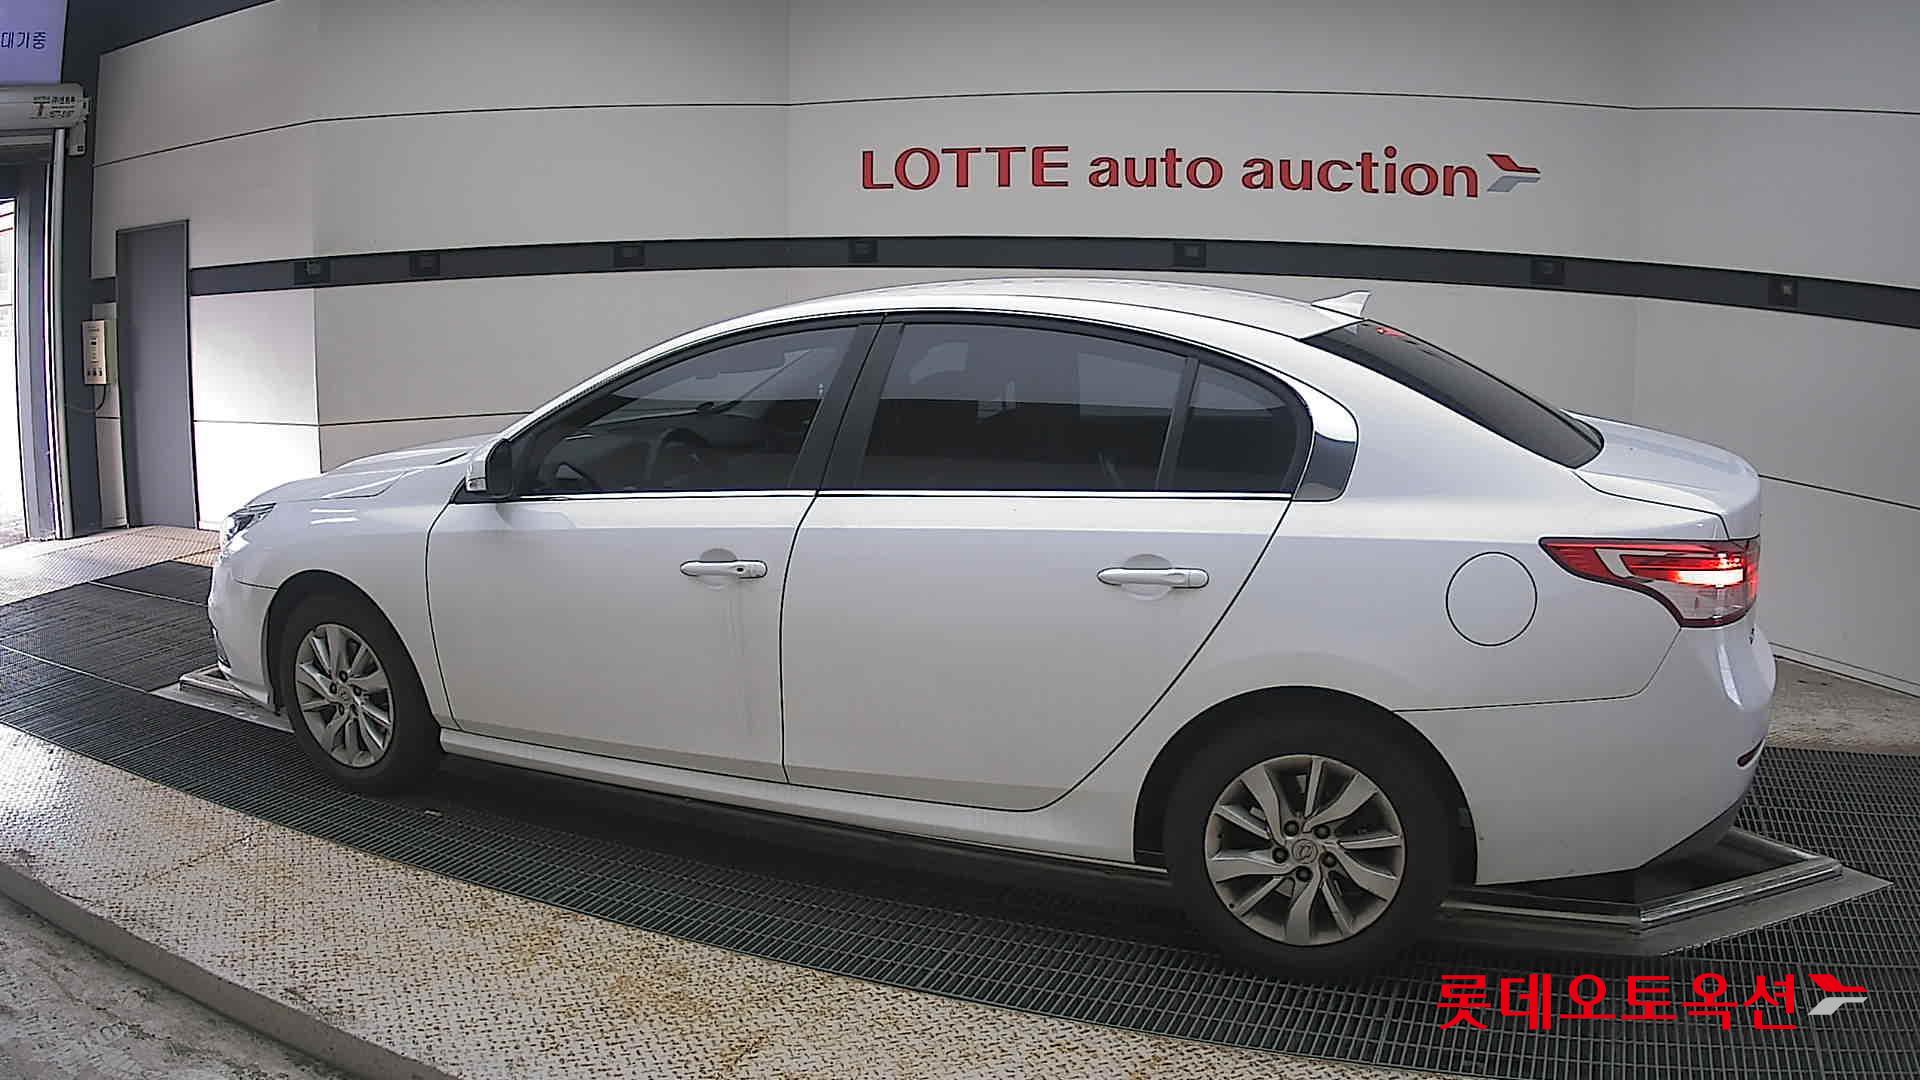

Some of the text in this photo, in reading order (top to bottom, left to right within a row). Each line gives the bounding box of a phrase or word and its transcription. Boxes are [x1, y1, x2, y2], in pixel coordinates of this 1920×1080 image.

[0, 31, 47, 50] 대기중
[861, 146, 1479, 198] LOTTE auto auction
